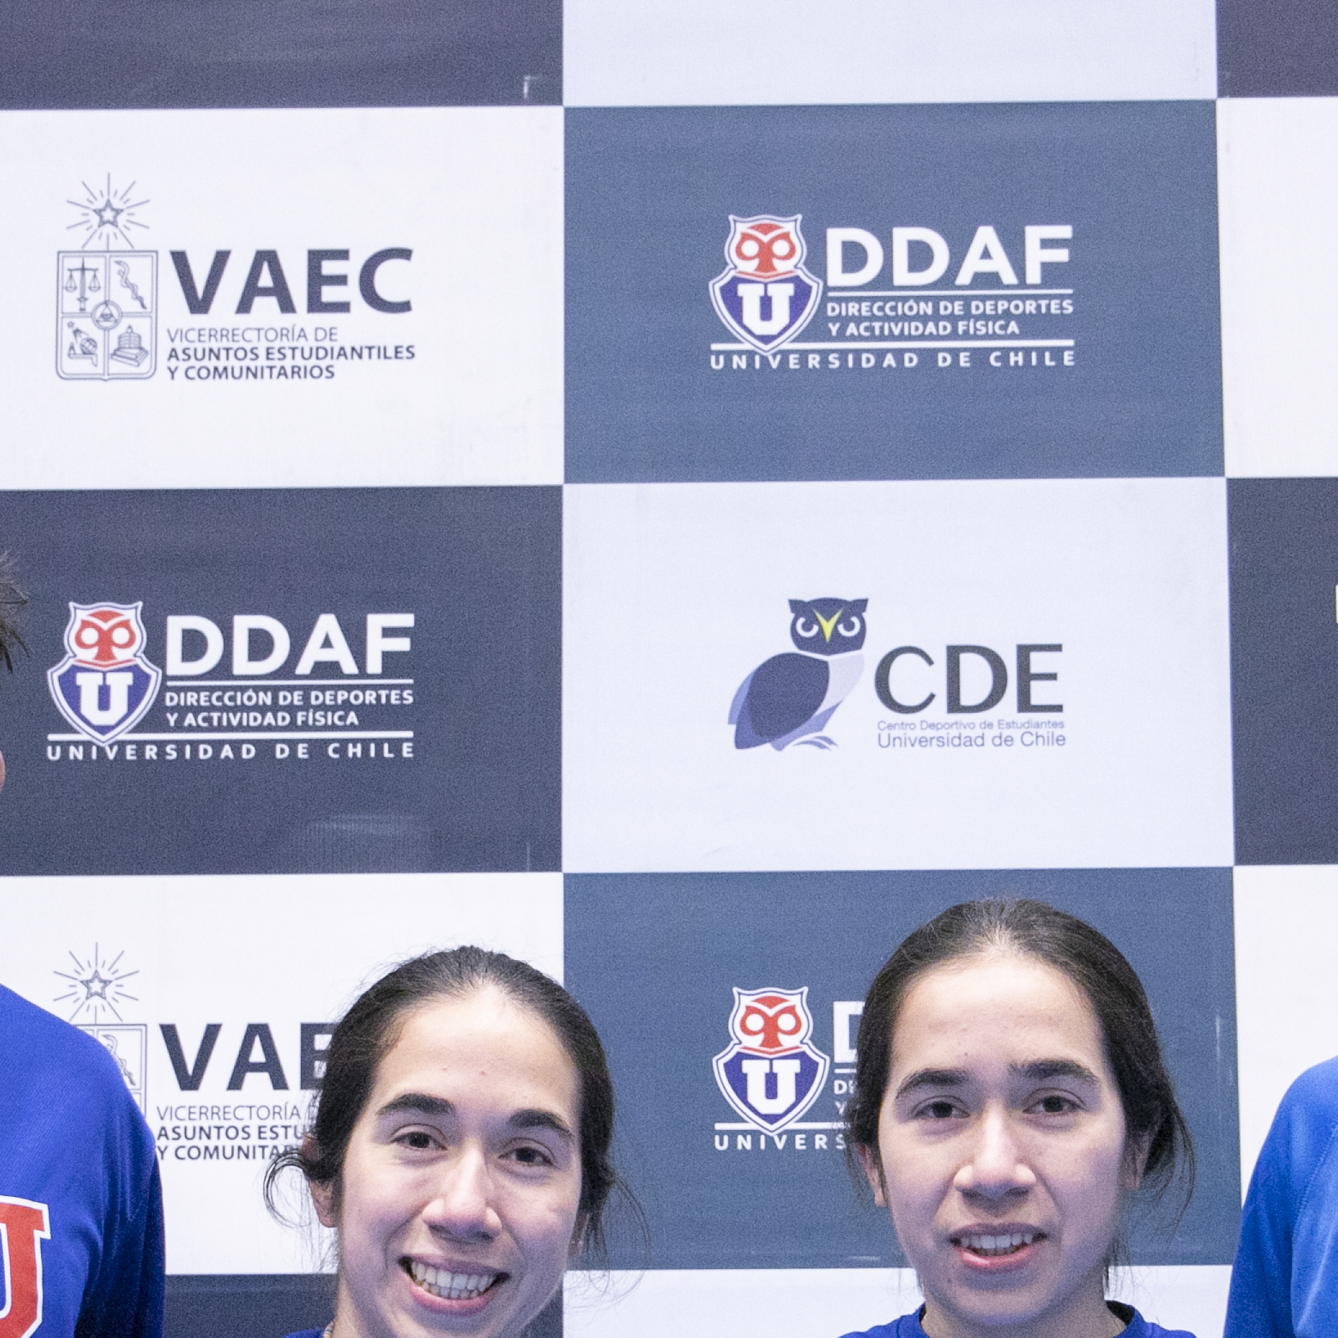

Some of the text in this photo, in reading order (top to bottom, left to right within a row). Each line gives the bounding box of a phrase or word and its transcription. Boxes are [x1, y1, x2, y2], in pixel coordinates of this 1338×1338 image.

[826, 225, 1073, 287] DDAF
[169, 247, 413, 314] VAEC
[737, 283, 795, 335] U
[827, 299, 1074, 317] DIRECCIÓN DE DEPORTES
[167, 324, 338, 343] VICERRECTORÍA DE
[828, 318, 1019, 337] Y ACTIVIDAD FÍSICA
[167, 345, 416, 362] ASUNTOS ESTUDIANTILES
[710, 350, 1074, 370] UNIVERSIDAD DE CHILE
[167, 364, 335, 380] Y COMUNITARIOS
[166, 613, 414, 676] DDAF
[874, 643, 1063, 714] CDE
[76, 672, 133, 726] U
[166, 689, 414, 707] DIRECCIÓN DE DEPORTES
[167, 708, 359, 727] Y ACTIVIDAD FÍSICA
[877, 719, 1065, 732] Centro Deportivo de Estudiantes
[878, 731, 1066, 748] Universidad de Chile
[47, 742, 414, 761] UNIVERSIDAD DE CHILE
[159, 1022, 335, 1091] VAE
[742, 1059, 800, 1114] U
[156, 1101, 301, 1121] VICERRECTORÍA
[157, 1125, 250, 1141] ASUNTOS
[714, 1134, 847, 1151] UNIVERS
[157, 1145, 168, 1161] Y
